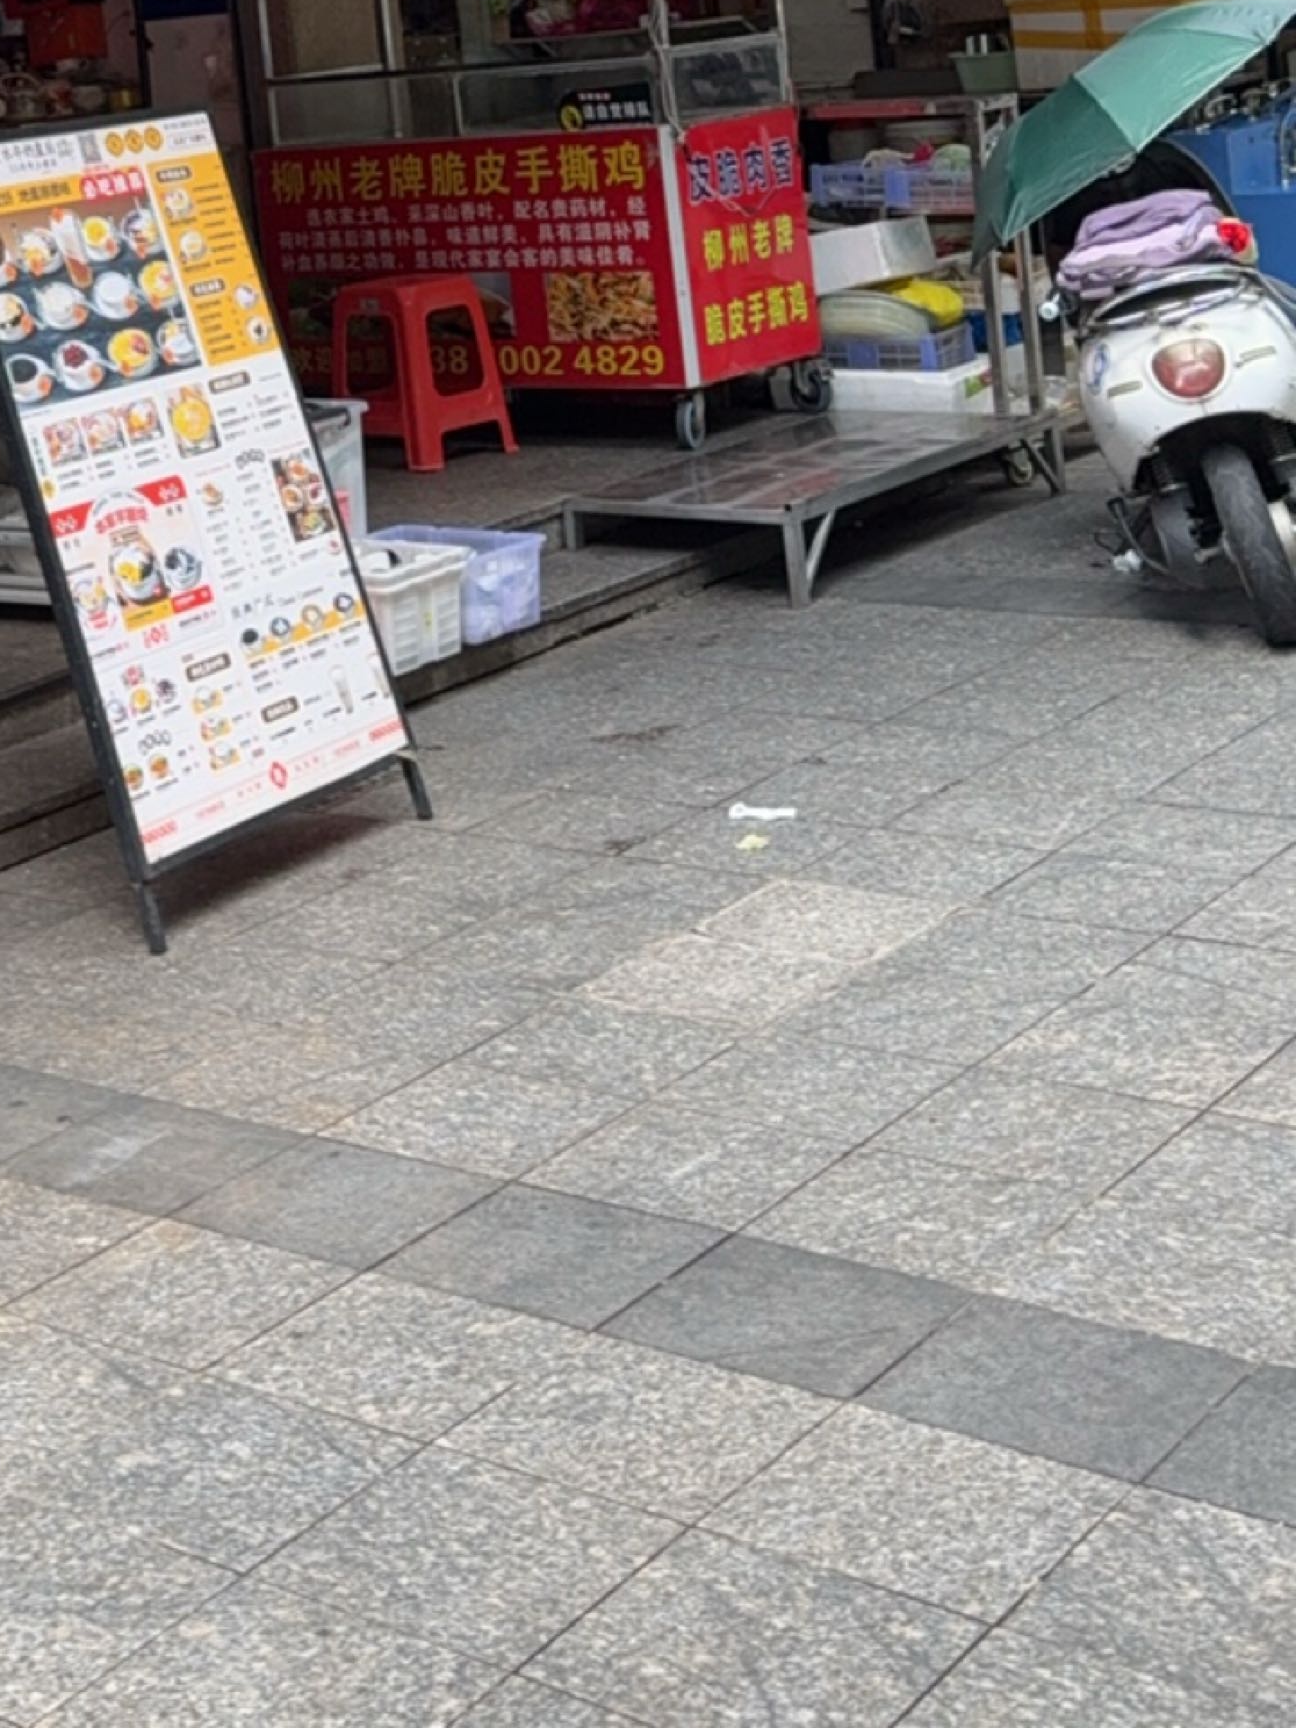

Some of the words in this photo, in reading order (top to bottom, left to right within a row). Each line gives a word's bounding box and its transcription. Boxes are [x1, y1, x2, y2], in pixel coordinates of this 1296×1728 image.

[270, 141, 647, 204] 柳州老牌脆皮手撕鸡
[704, 214, 794, 270] 柳州老牌
[705, 281, 809, 346] 脆皮手撕鸡
[575, 344, 664, 376] 4829
